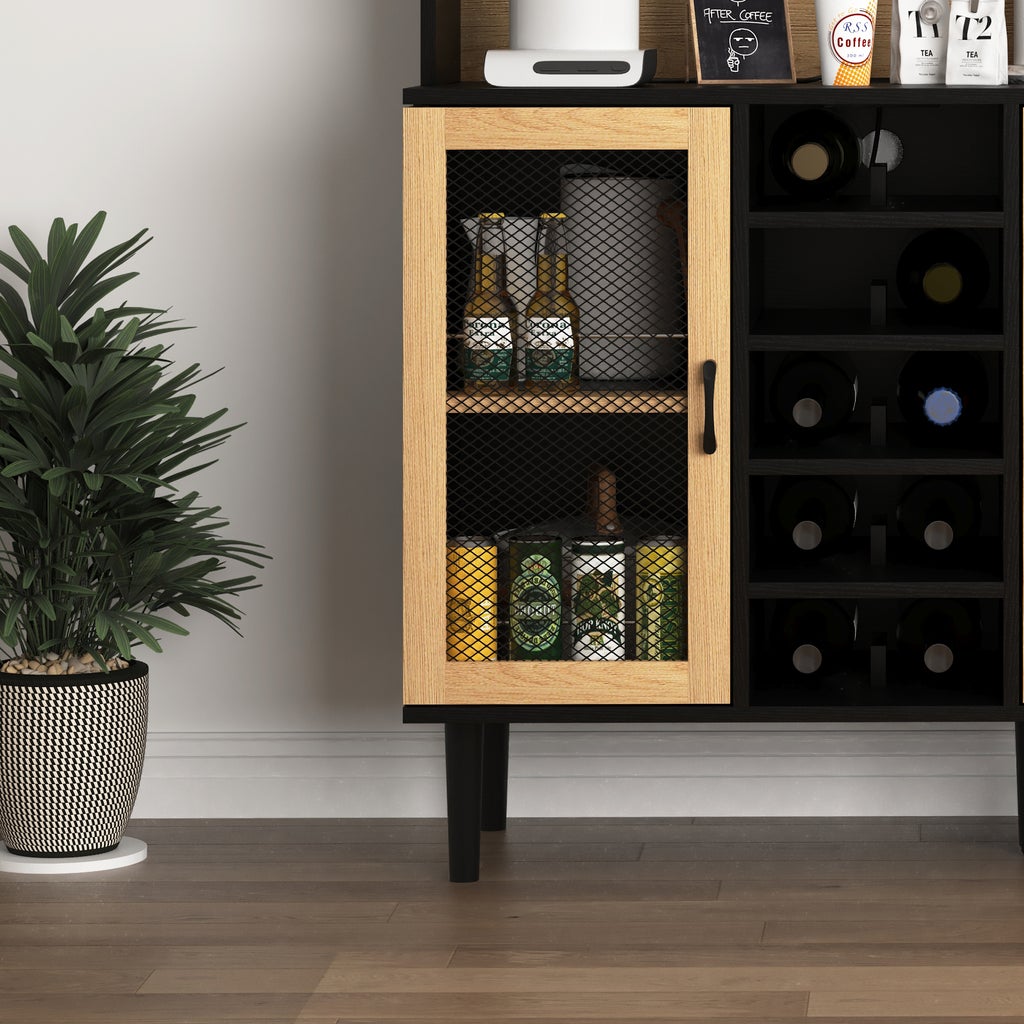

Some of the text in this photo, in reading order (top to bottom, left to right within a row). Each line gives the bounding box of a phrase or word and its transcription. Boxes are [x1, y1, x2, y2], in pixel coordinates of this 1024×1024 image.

[703, 7, 773, 24] AFTER COFFEE
[842, 21, 869, 33] RSS
[955, 14, 992, 40] T2
[837, 37, 871, 48] Coffee
[920, 49, 933, 57] TEA
